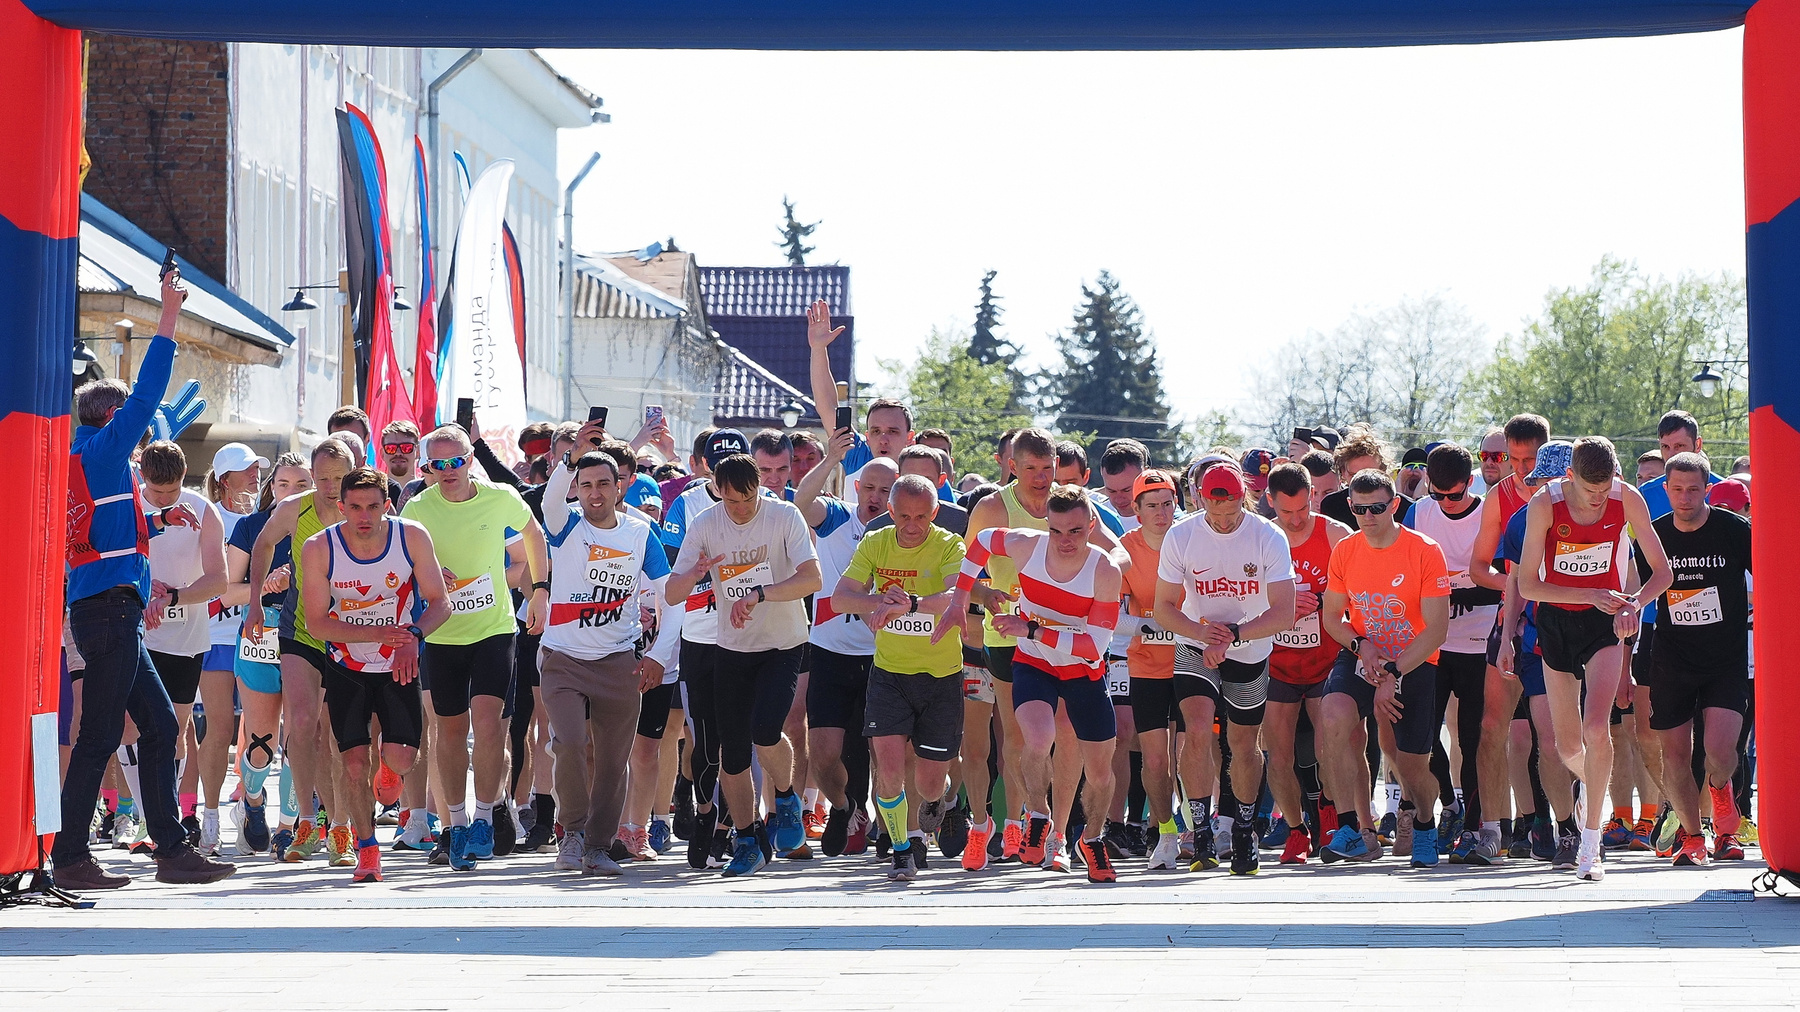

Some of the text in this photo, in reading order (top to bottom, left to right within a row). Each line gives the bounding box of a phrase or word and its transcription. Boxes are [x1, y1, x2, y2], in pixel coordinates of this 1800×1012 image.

[713, 439, 741, 451] FILA
[593, 548, 609, 558] 21,1
[1559, 560, 1608, 573] 00034
[589, 568, 632, 587] 00188
[1677, 572, 1704, 581] Moscow
[334, 579, 362, 589] RUSSIA
[1195, 576, 1260, 596] RUSSIA
[1670, 592, 1684, 600] 21,1
[167, 606, 184, 619] 61
[1674, 608, 1718, 622] 00151
[1146, 630, 1174, 641] 000
[1274, 632, 1319, 645] 00030
[1110, 681, 1128, 692] 56
